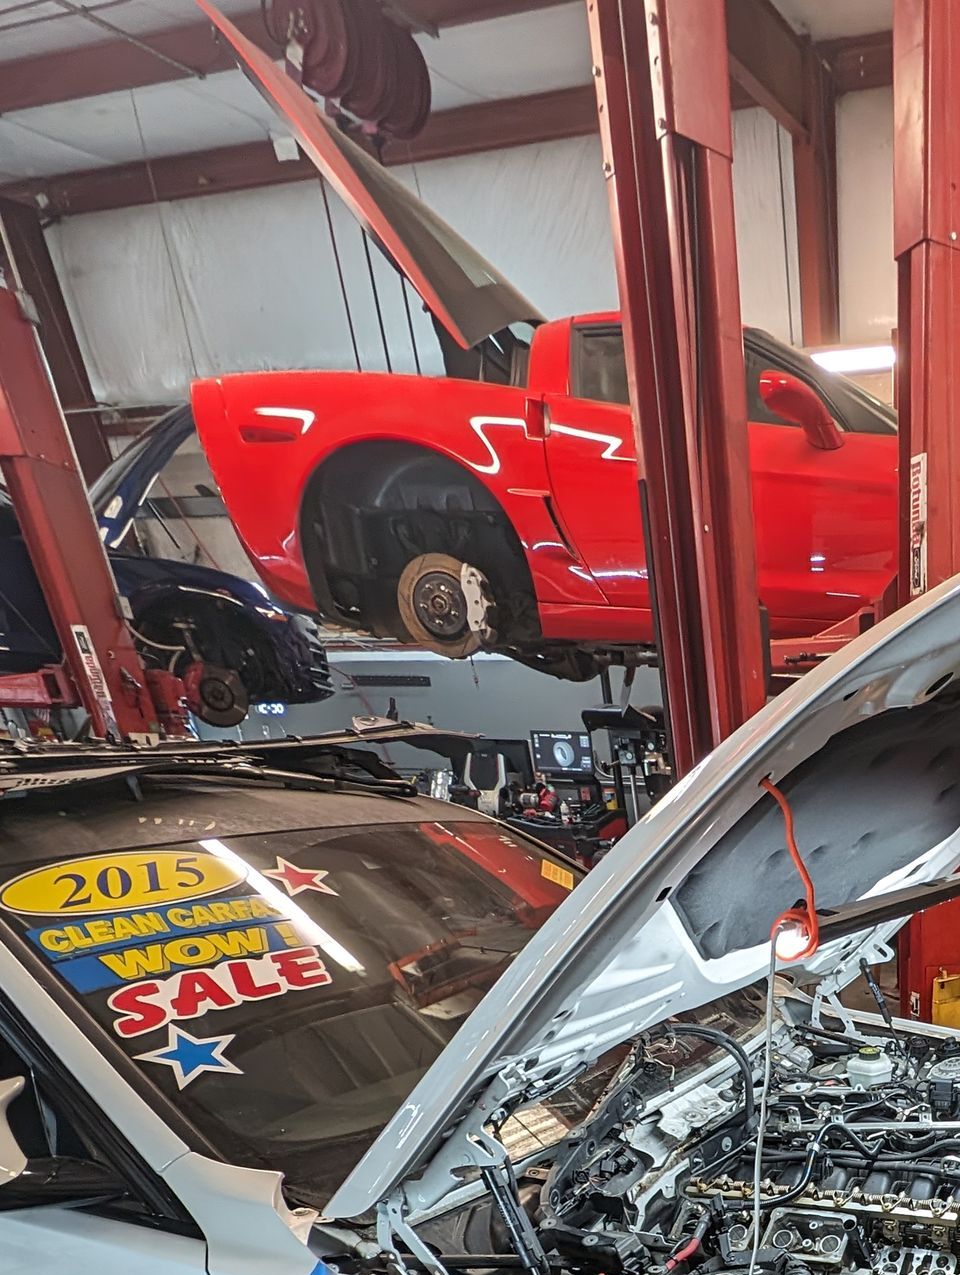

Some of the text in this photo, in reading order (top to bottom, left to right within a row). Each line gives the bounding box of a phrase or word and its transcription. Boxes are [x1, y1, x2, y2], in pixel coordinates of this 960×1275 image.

[53, 856, 205, 909] 2015
[39, 911, 171, 953] CLEAN
[99, 926, 269, 980] WOW
[111, 947, 329, 1036] SALE
